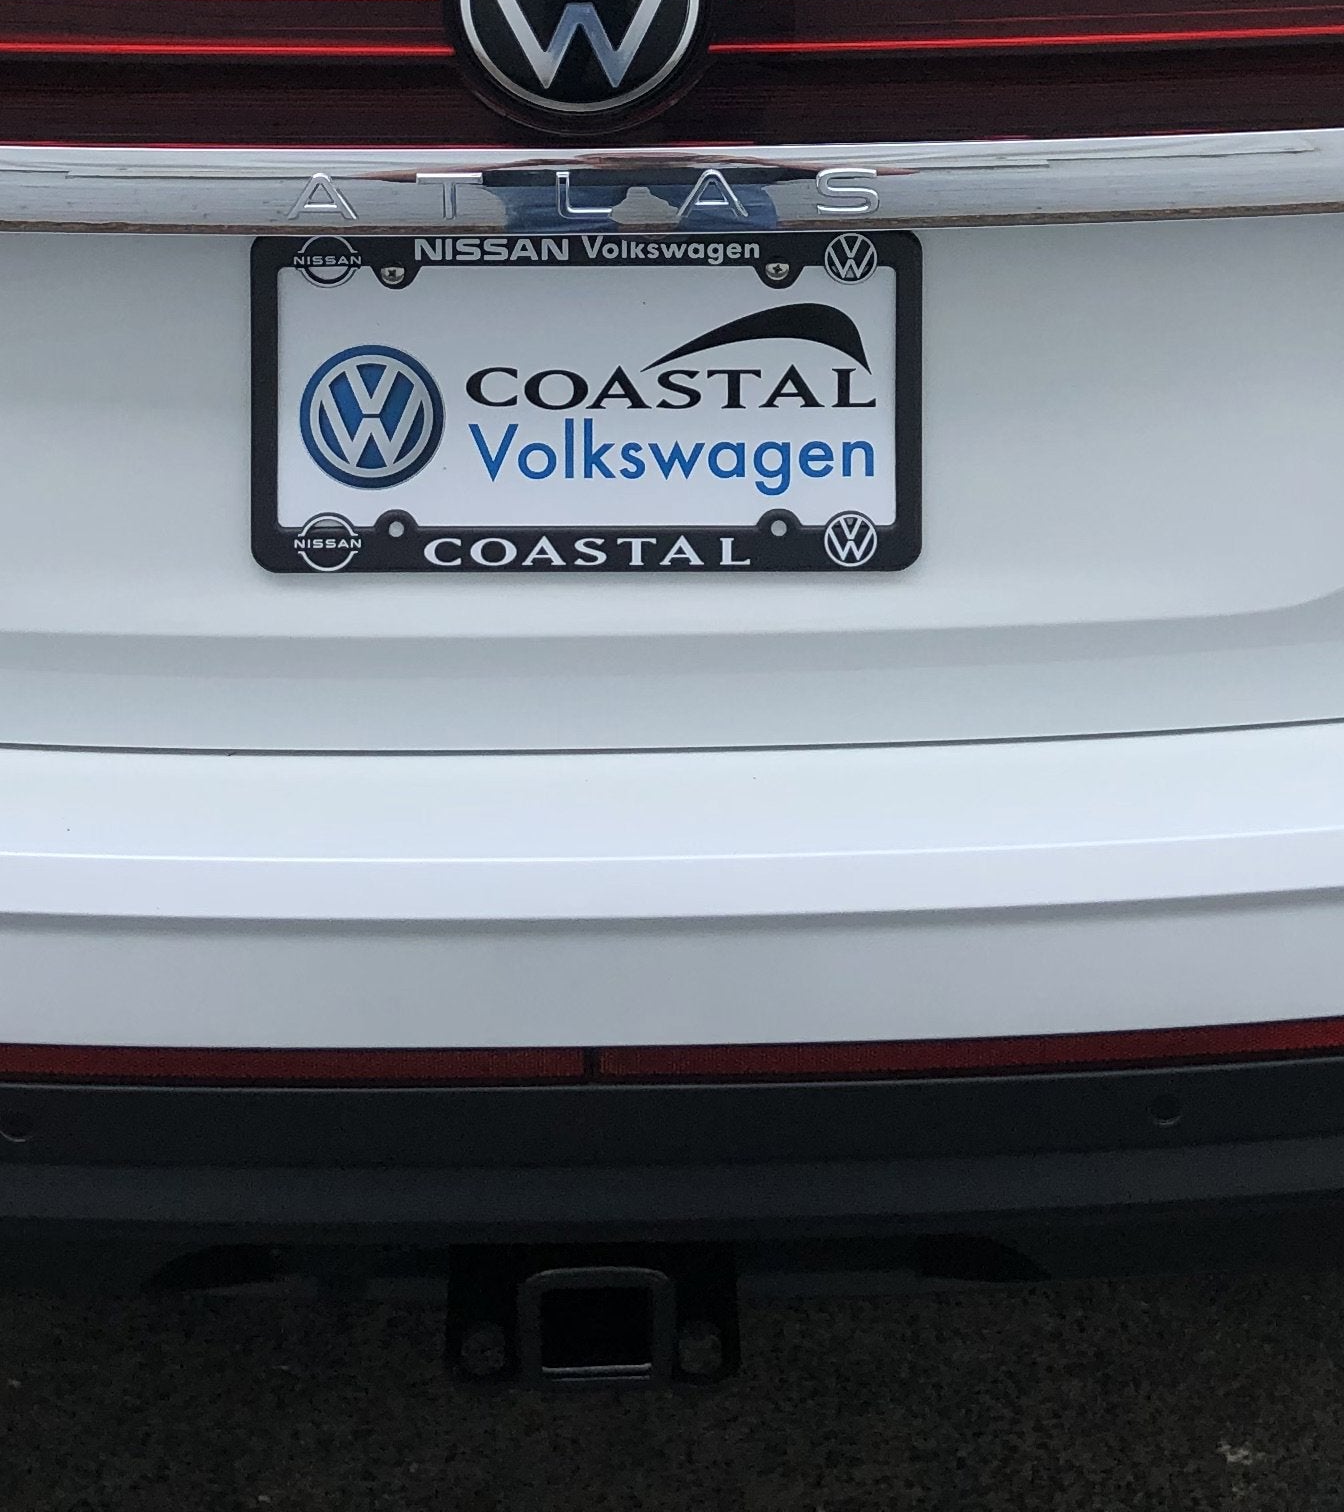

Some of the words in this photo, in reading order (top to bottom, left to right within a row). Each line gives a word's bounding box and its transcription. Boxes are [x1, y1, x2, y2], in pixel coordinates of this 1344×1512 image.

[286, 168, 880, 220] ATLAS
[293, 255, 362, 266] NISSAN
[414, 238, 569, 261] NISSAN
[581, 235, 760, 265] Volkswagen
[465, 365, 877, 411] COASTAL
[468, 418, 875, 496] Volkswagen
[294, 538, 362, 549] NISSAN
[423, 535, 751, 566] COASTAL
